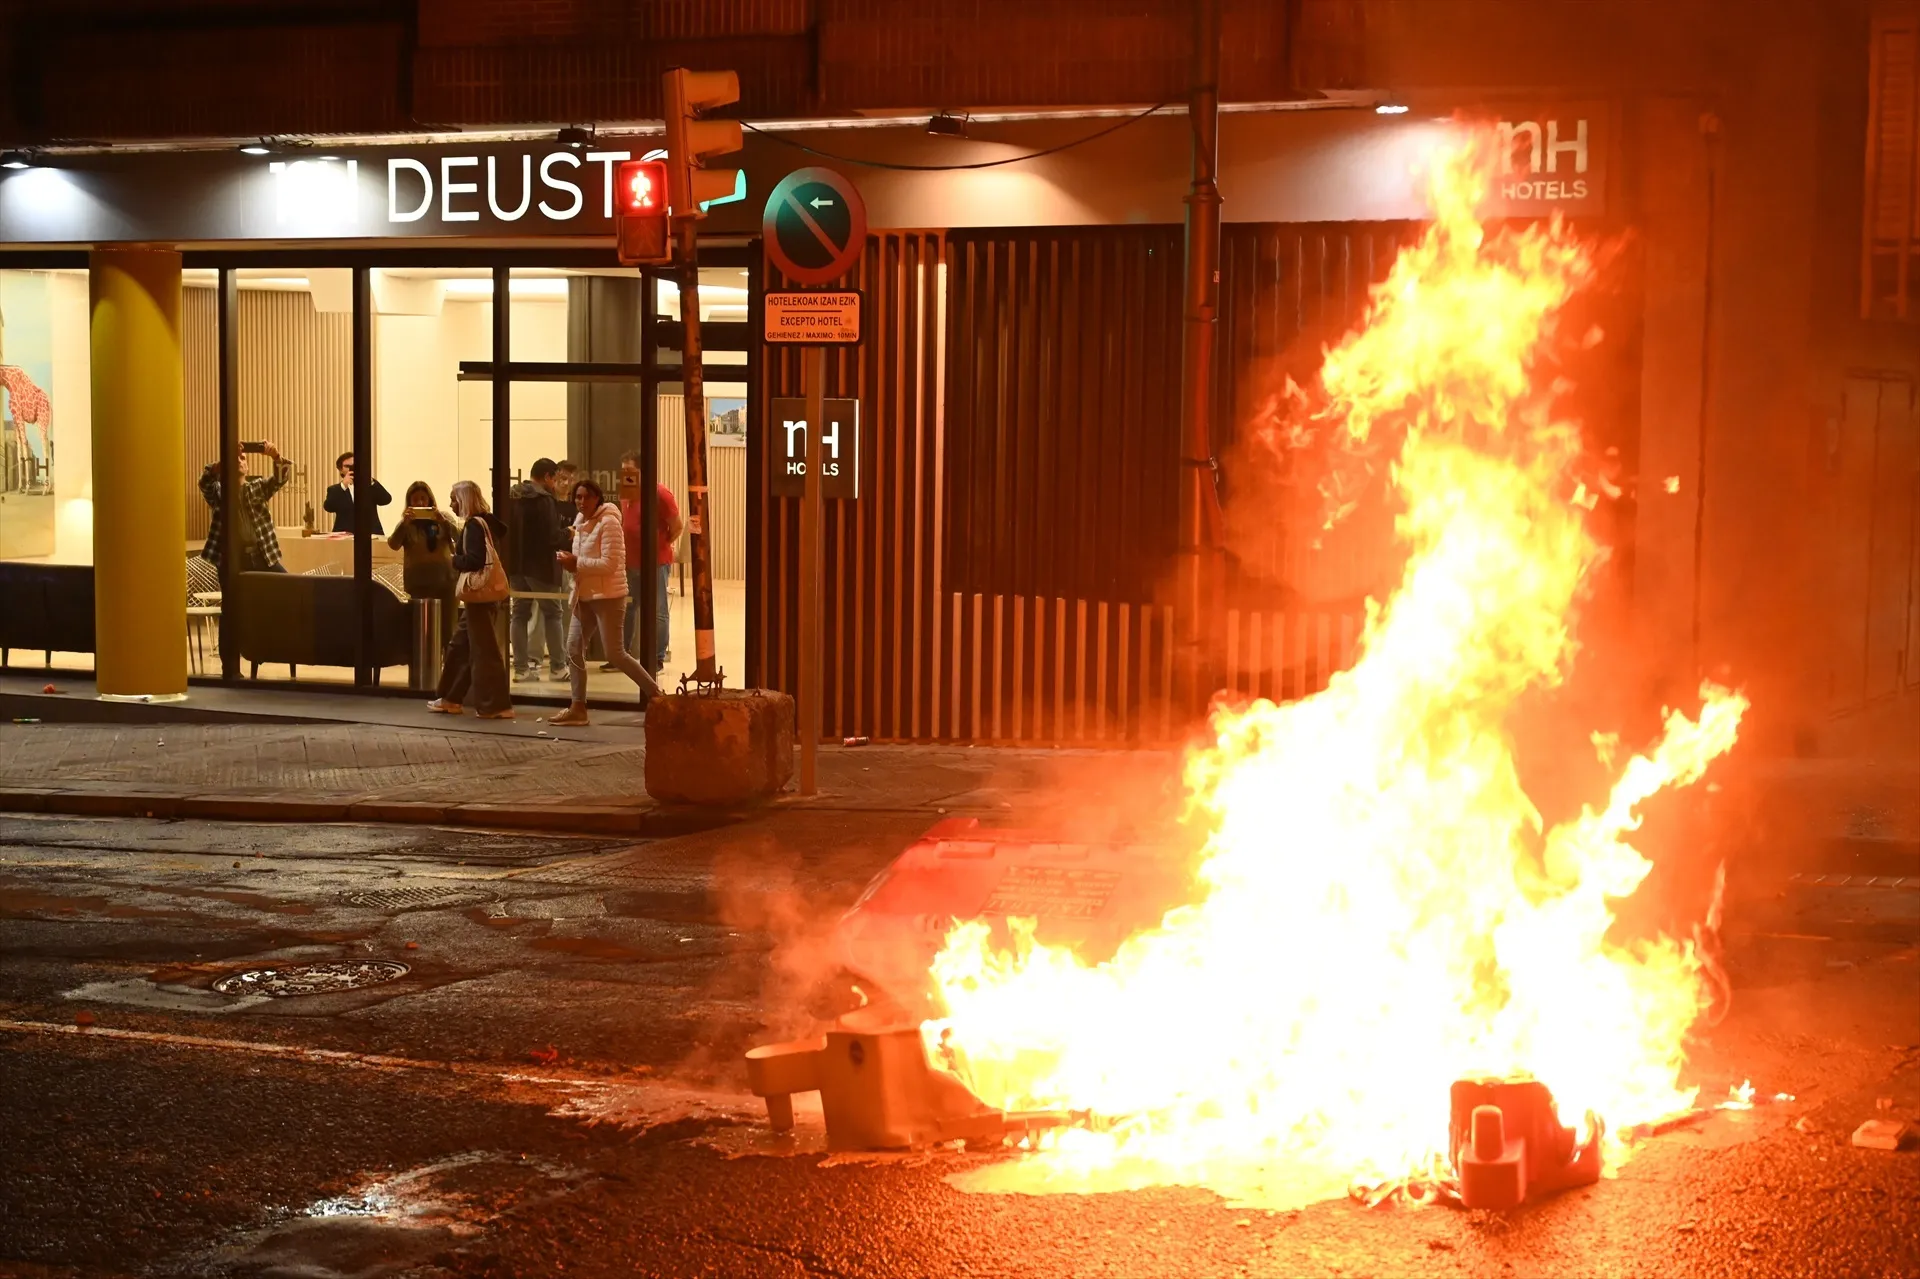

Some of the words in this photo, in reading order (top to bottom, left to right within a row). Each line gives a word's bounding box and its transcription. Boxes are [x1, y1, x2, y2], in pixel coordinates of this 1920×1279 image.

[387, 151, 669, 223] DEUST
[1502, 179, 1588, 200] HOTELS
[768, 296, 818, 306] HOTELEKOAK
[820, 296, 837, 306] IZAN
[839, 296, 856, 306] EZIK
[780, 316, 816, 326] EXCEPTO
[817, 317, 843, 326] HOTEL
[767, 331, 800, 339] GEHIENEZ
[786, 462, 838, 476] HOLS
